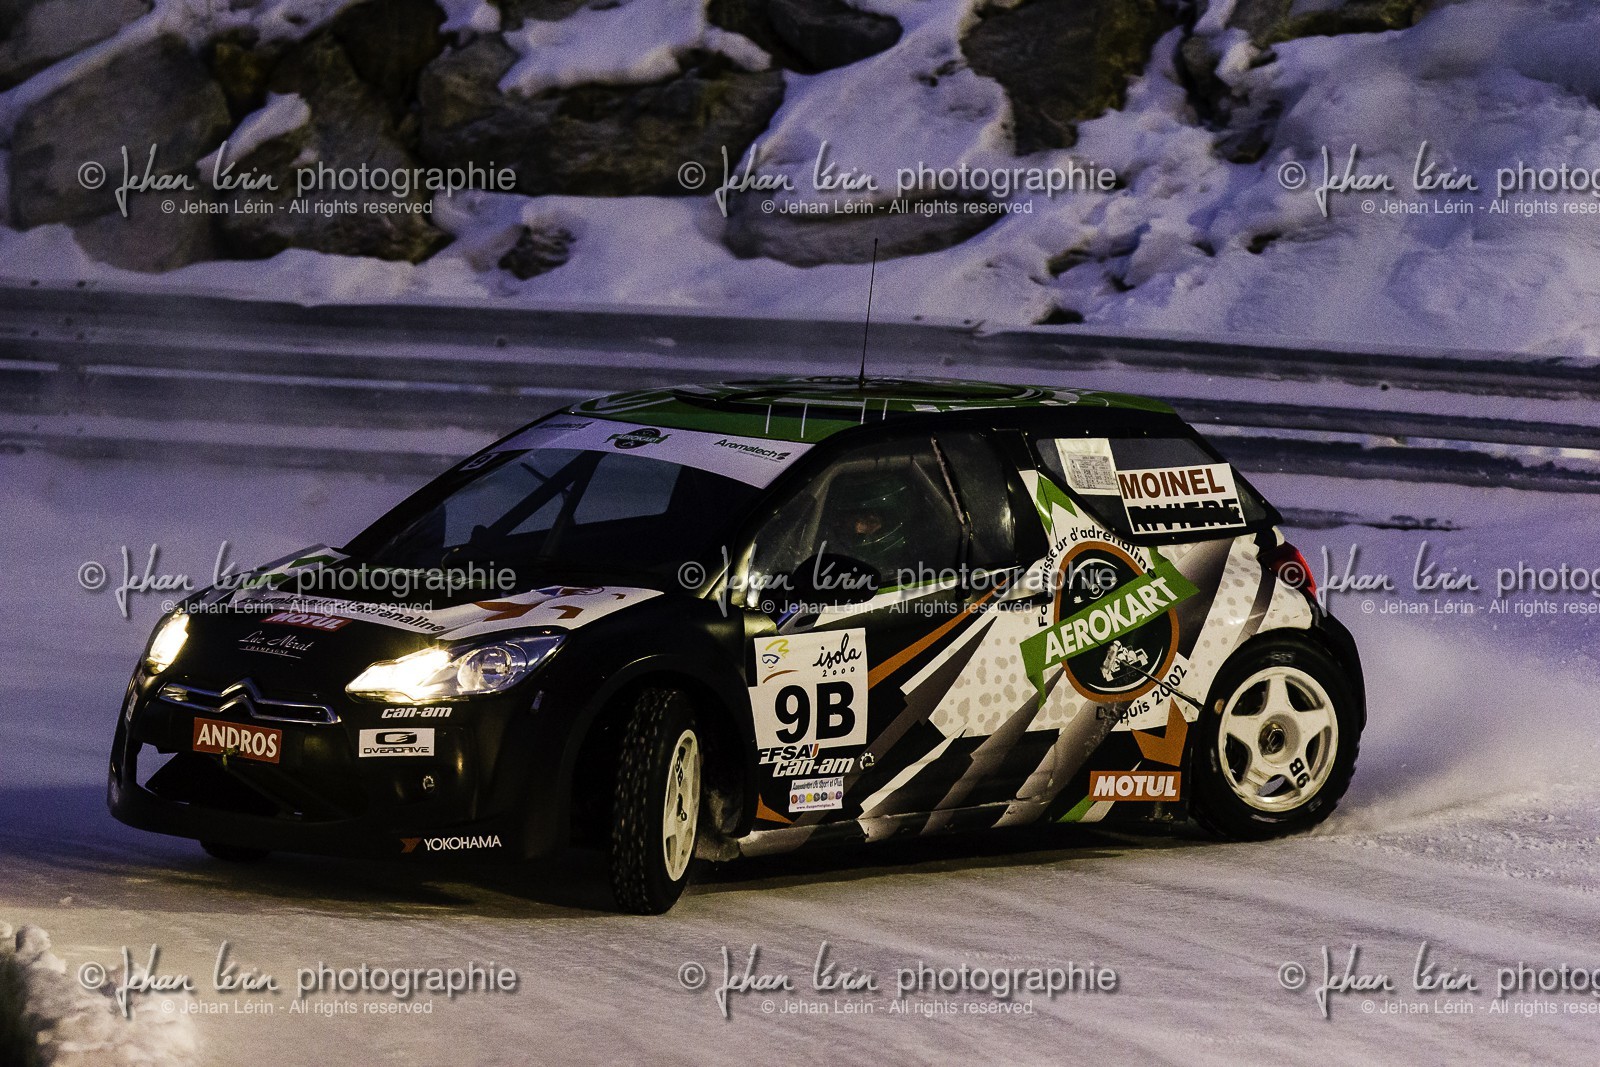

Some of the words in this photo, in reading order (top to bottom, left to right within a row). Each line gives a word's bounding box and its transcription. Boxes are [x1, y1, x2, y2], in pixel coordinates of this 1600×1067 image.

[713, 438, 778, 458] Aromatech
[1119, 467, 1226, 500] MOINEL
[265, 612, 345, 629] MOTUL
[1045, 576, 1179, 665] AEROKART
[238, 630, 265, 644] Luc
[812, 632, 862, 670] isola
[1096, 700, 1151, 724] Dpuis
[1151, 664, 1188, 706] 2002
[381, 706, 453, 719] can-am
[775, 681, 856, 744] 9B
[196, 722, 278, 759] ANDROS
[363, 746, 430, 755] OVERDRIVE
[758, 744, 813, 762] FFSA
[773, 756, 855, 778] can-am
[1093, 775, 1177, 797] MOTUL
[423, 834, 502, 852] YOKOHAMA
